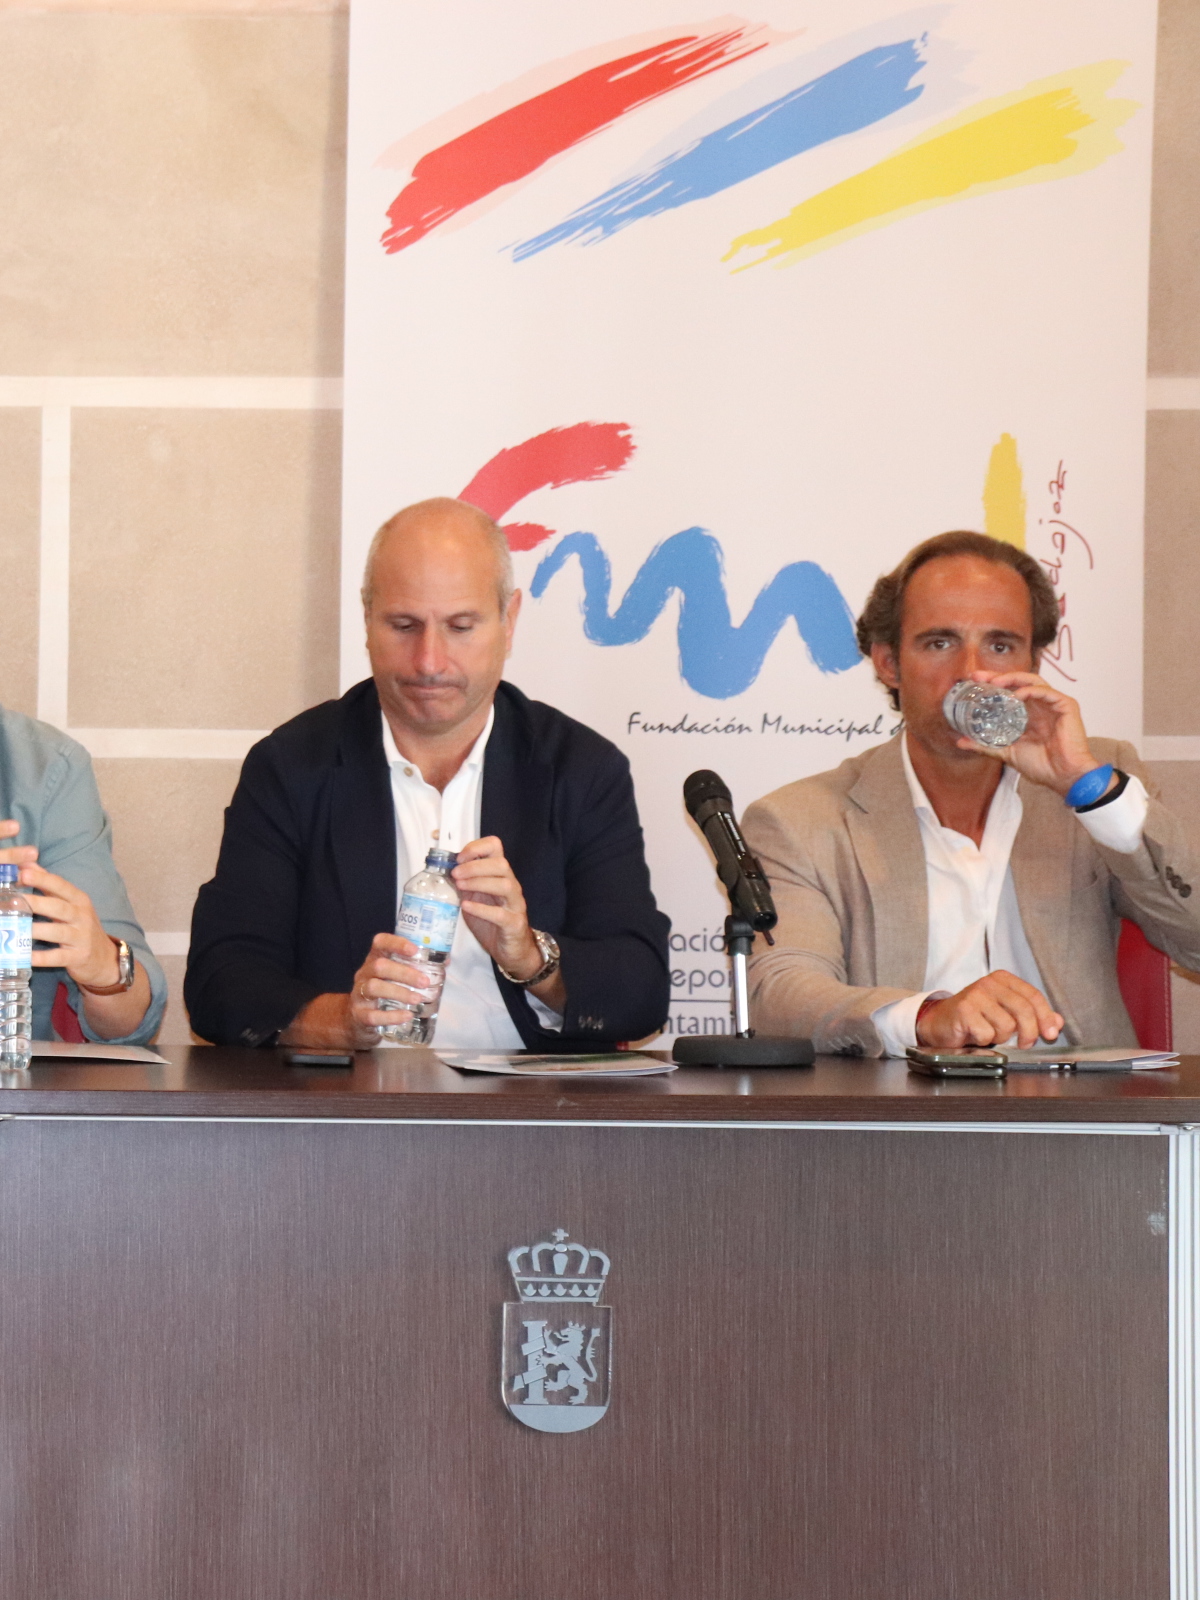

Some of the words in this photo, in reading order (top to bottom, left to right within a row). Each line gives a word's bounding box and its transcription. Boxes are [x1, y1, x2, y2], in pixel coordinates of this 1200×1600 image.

[628, 711, 753, 735] Fundación
[761, 712, 882, 742] Municipal
[669, 927, 726, 952] ació
[662, 1012, 735, 1035] ntami
